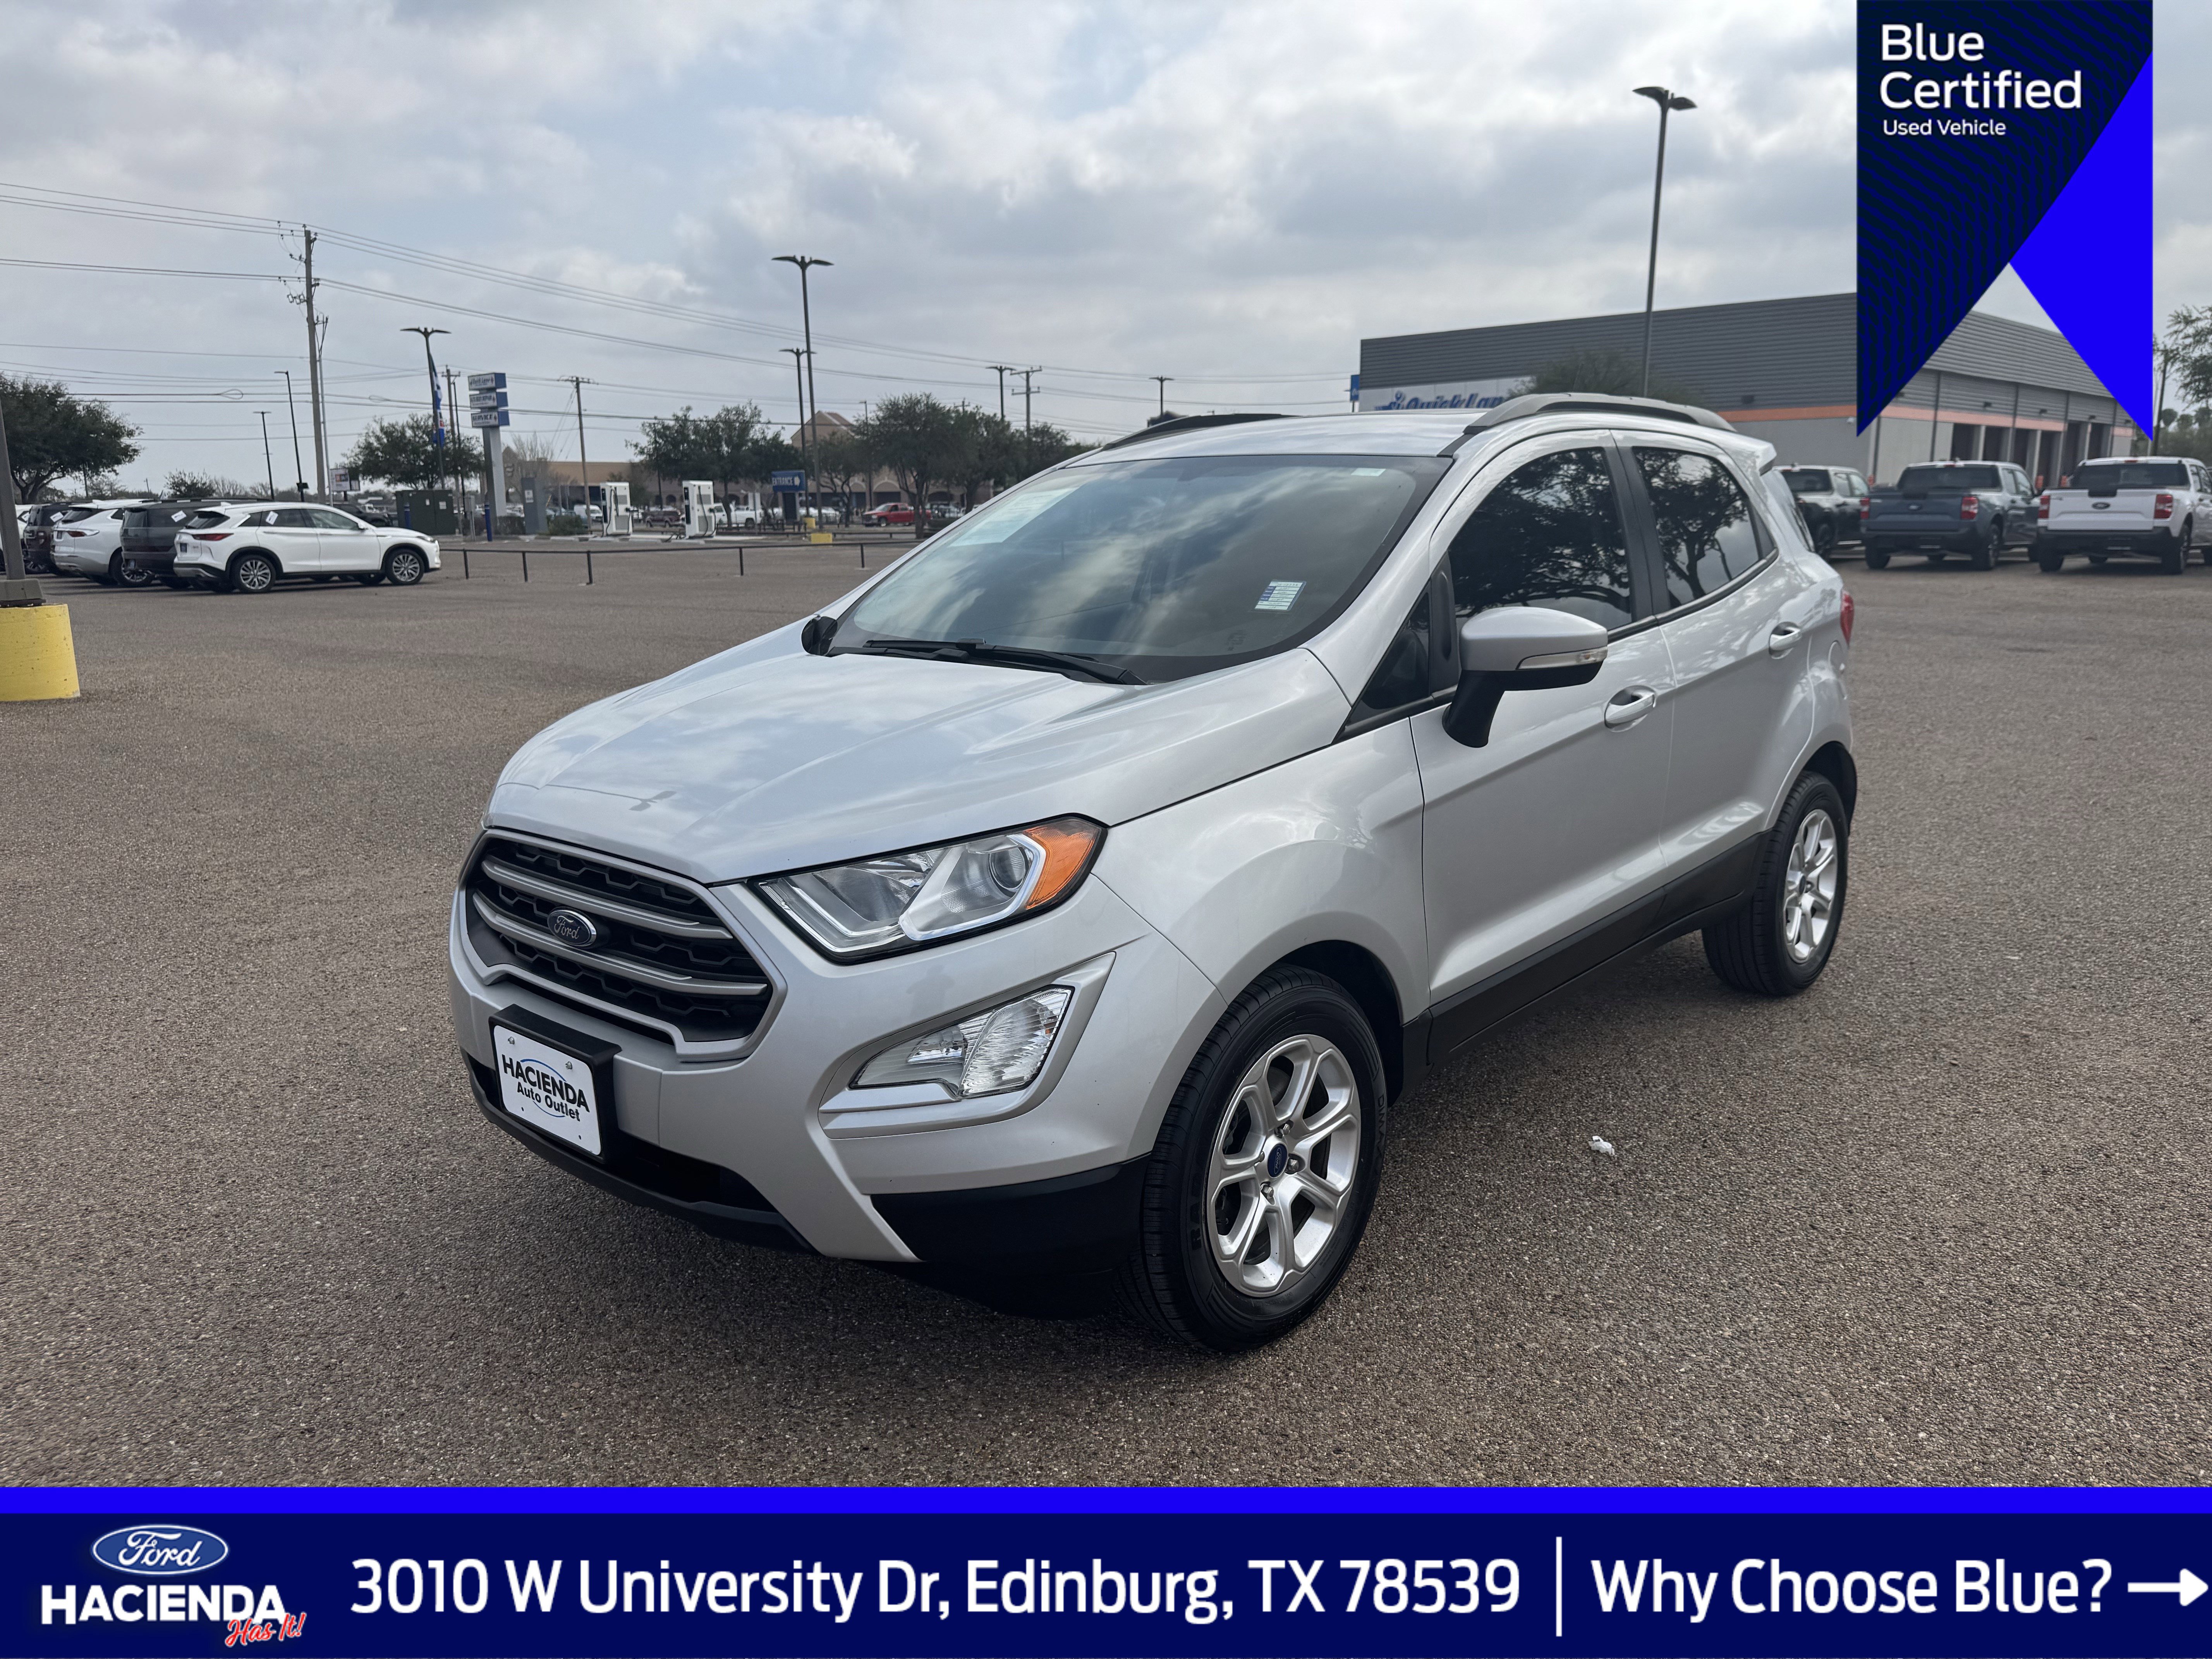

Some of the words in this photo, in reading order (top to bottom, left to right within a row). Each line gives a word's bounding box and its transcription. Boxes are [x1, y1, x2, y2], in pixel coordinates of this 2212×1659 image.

[772, 477, 793, 486] ENTRANCE
[554, 915, 580, 939] Ford
[501, 1054, 590, 1113] HACIENDA
[517, 1081, 541, 1103] Auto
[544, 1095, 580, 1122] Outlet
